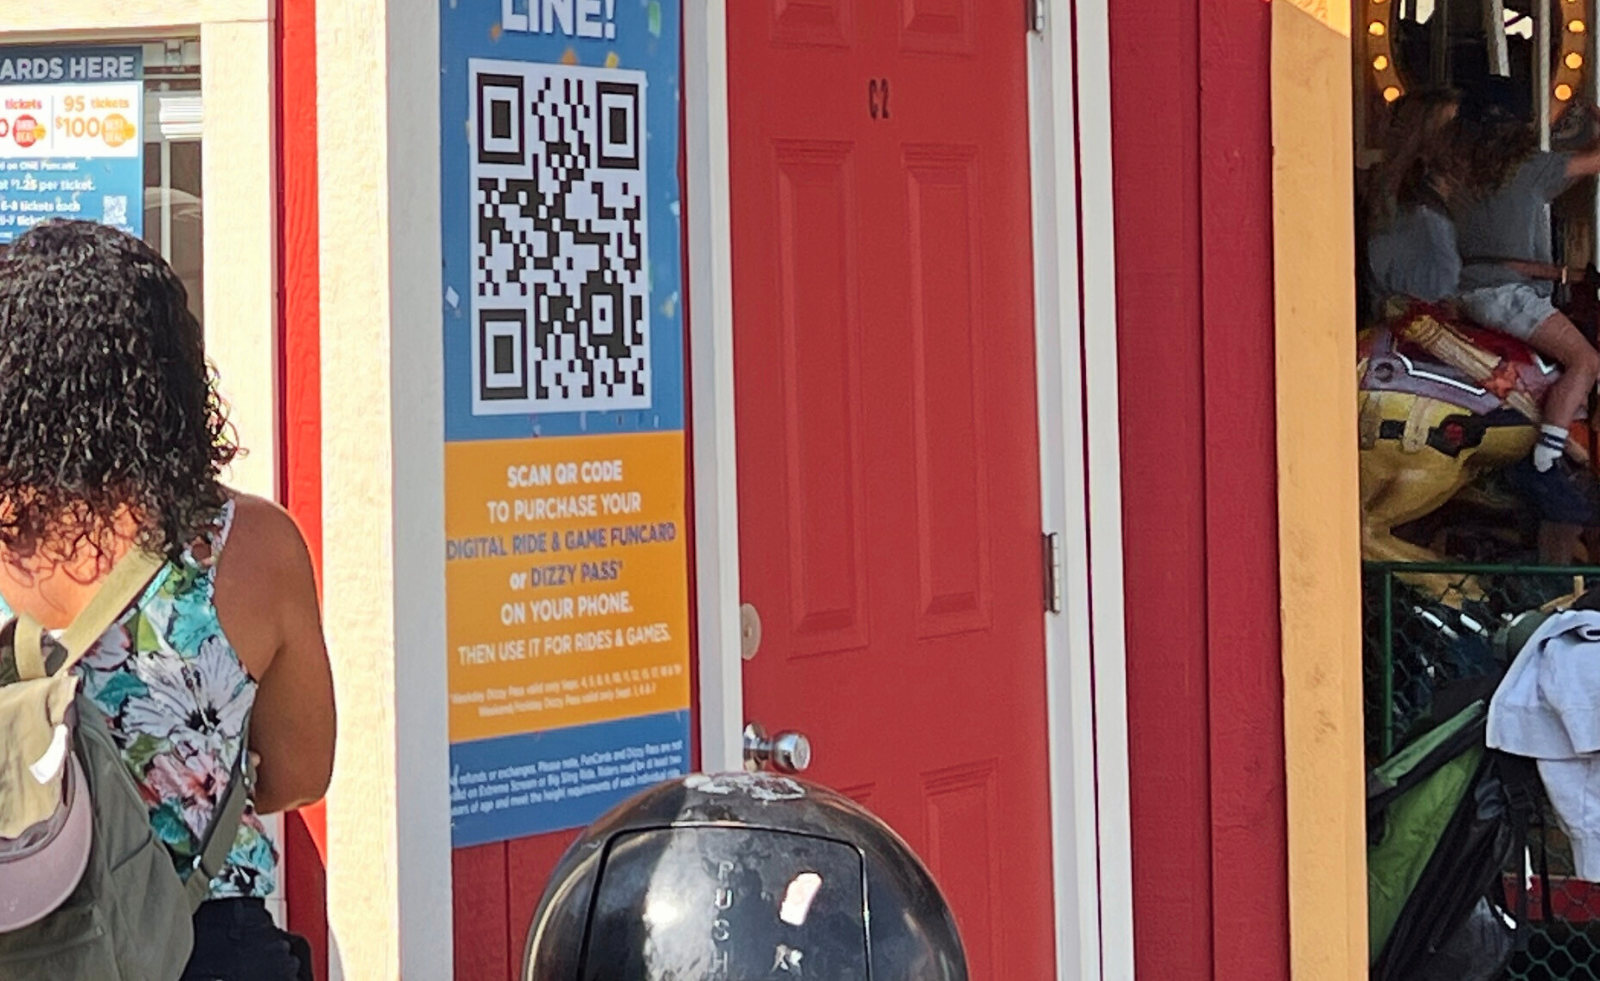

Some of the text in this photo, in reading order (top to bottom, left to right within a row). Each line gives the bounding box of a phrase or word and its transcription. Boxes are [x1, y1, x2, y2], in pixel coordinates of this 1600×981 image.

[70, 56, 134, 80] HERE
[5, 98, 42, 110] tickets
[64, 95, 85, 112] 95
[55, 116, 101, 138] $100
[507, 460, 623, 488] SCAN QR CODE
[487, 491, 641, 524] TO PURCHASE YOUR
[446, 522, 677, 561] DIGITAL RIDE & GAME FUNCARD
[510, 571, 527, 591] or
[531, 564, 577, 588] DIZZY
[501, 591, 634, 626] ON YOUR PHONE.
[458, 623, 672, 666] THEN USE IT FOR RIDES & GAMES.
[708, 859, 734, 975] PUSH
